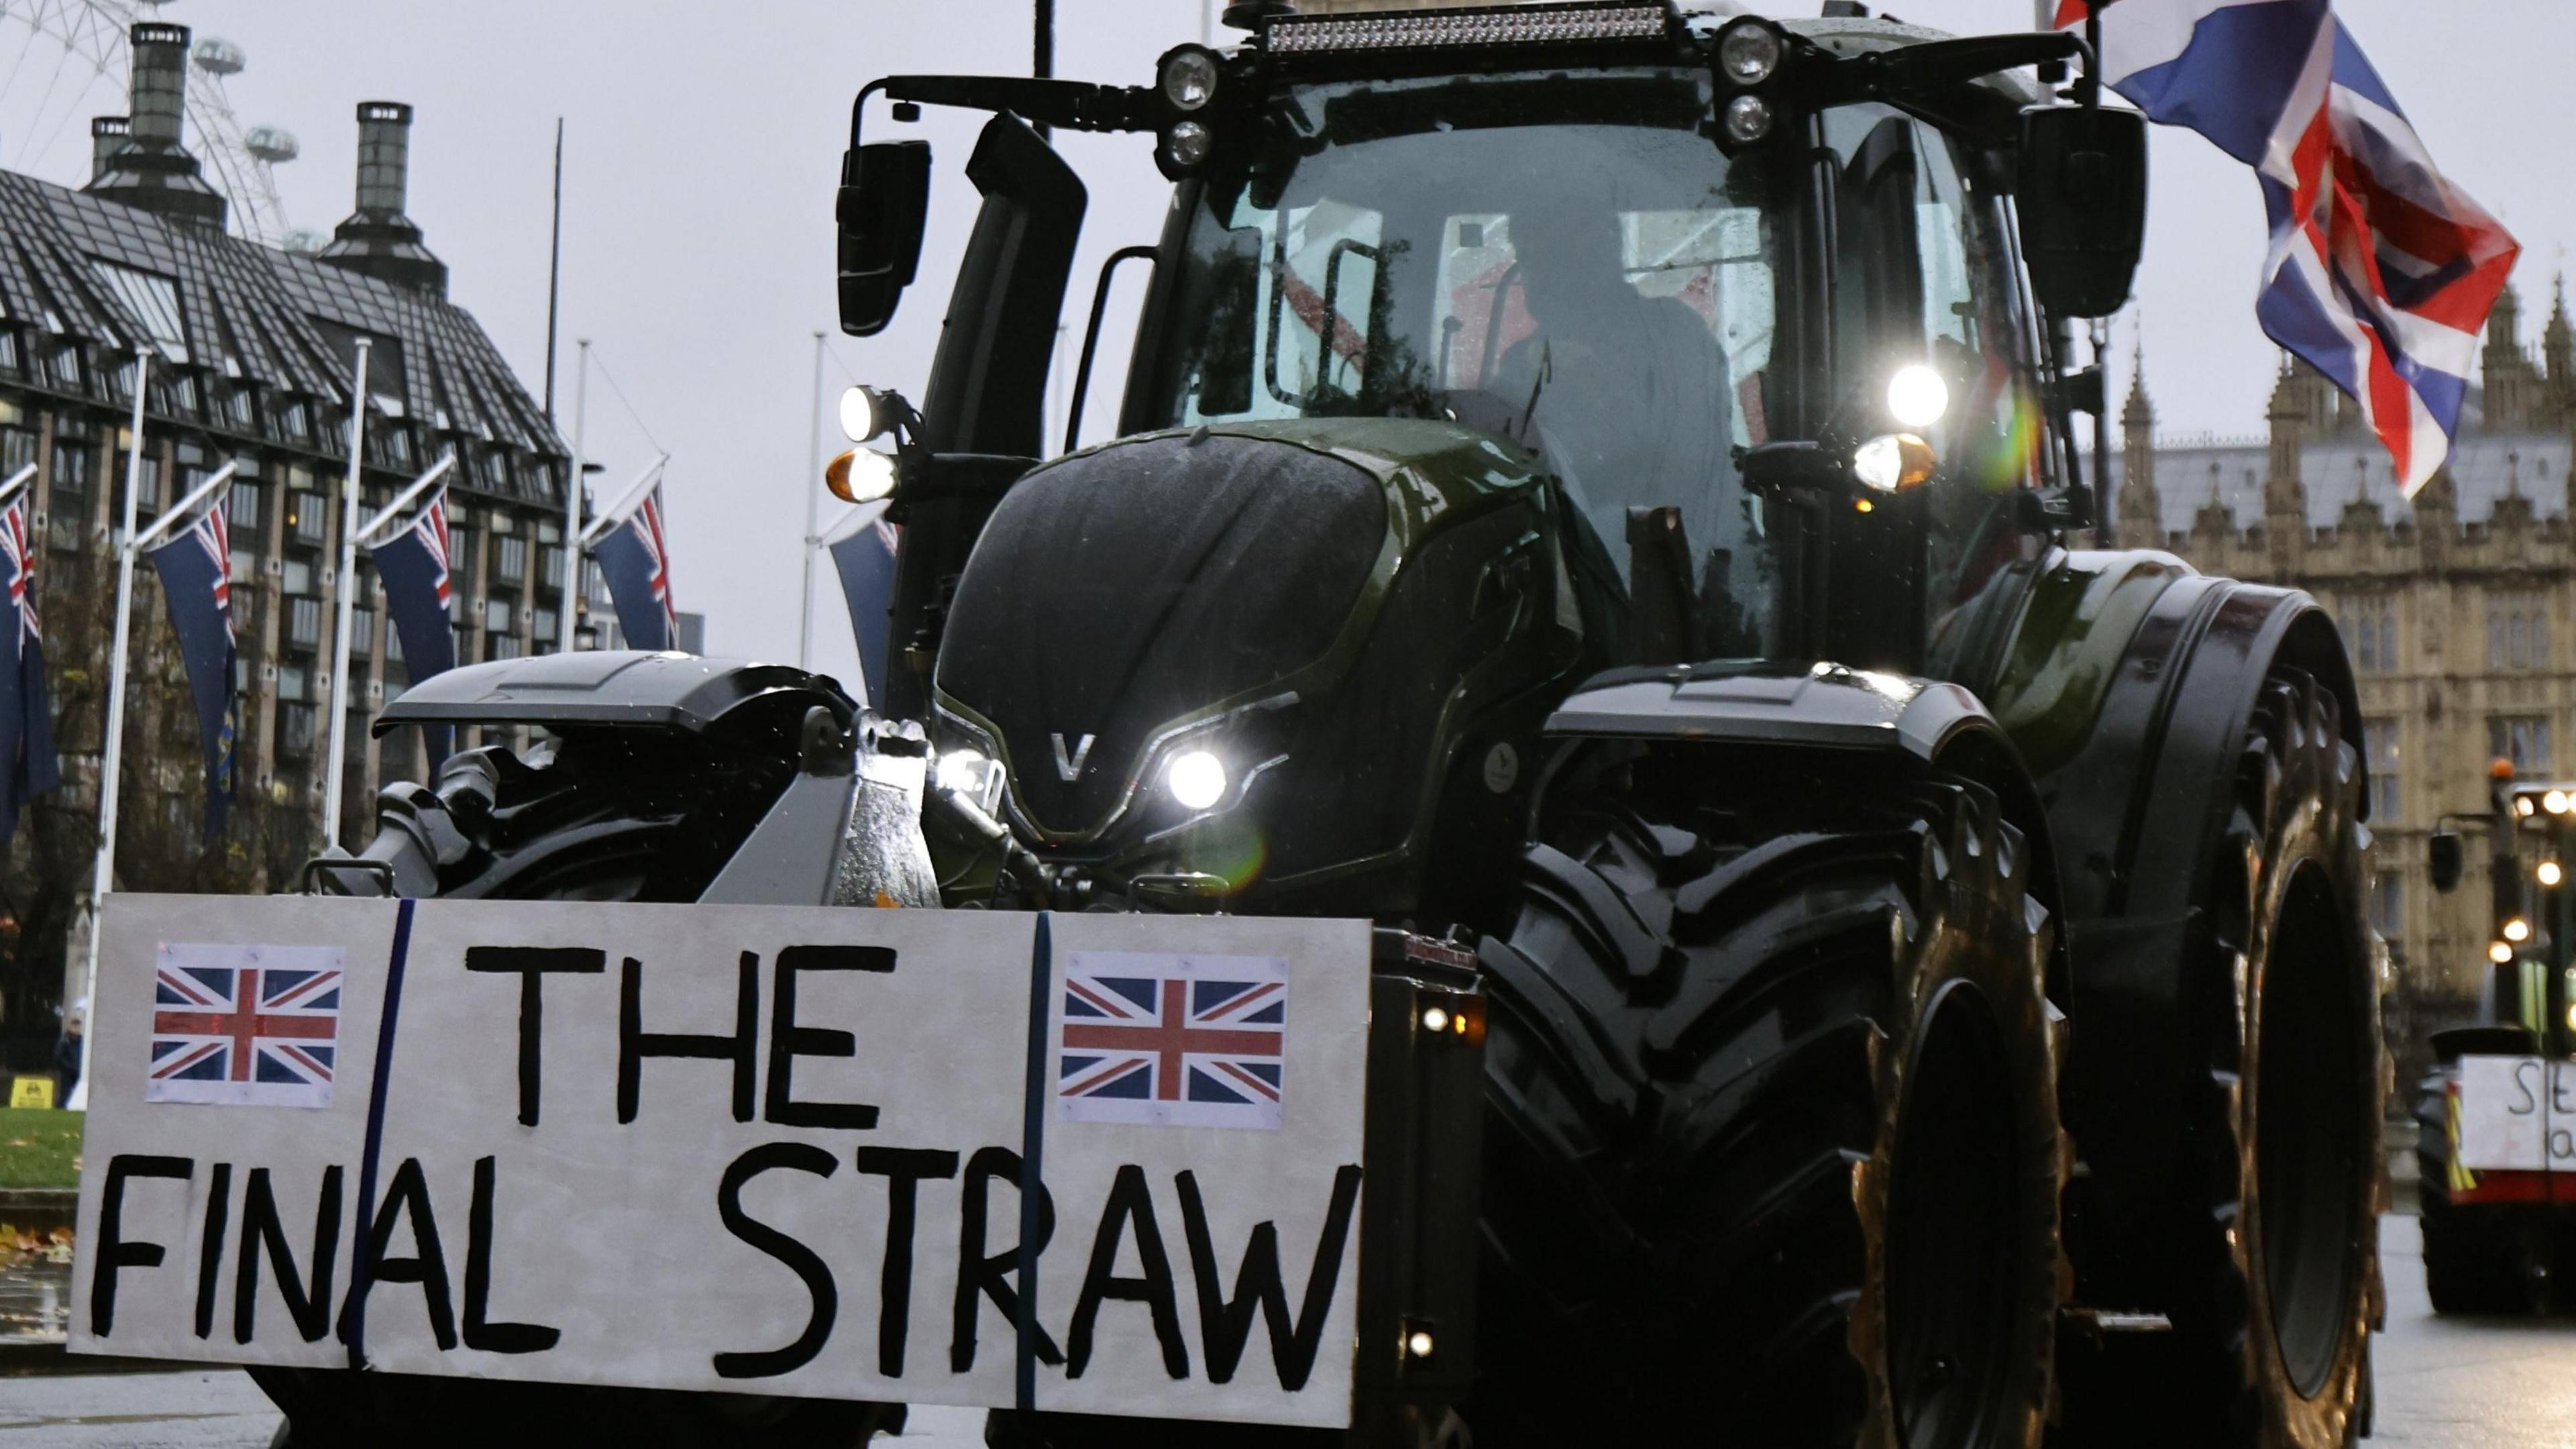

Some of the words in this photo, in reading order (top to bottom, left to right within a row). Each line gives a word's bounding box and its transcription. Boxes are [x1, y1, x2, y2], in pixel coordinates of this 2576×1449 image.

[1051, 733, 1096, 781] V
[466, 945, 898, 1130] THE
[91, 1155, 561, 1354] FINAL
[713, 1142, 1362, 1392] STRAW
